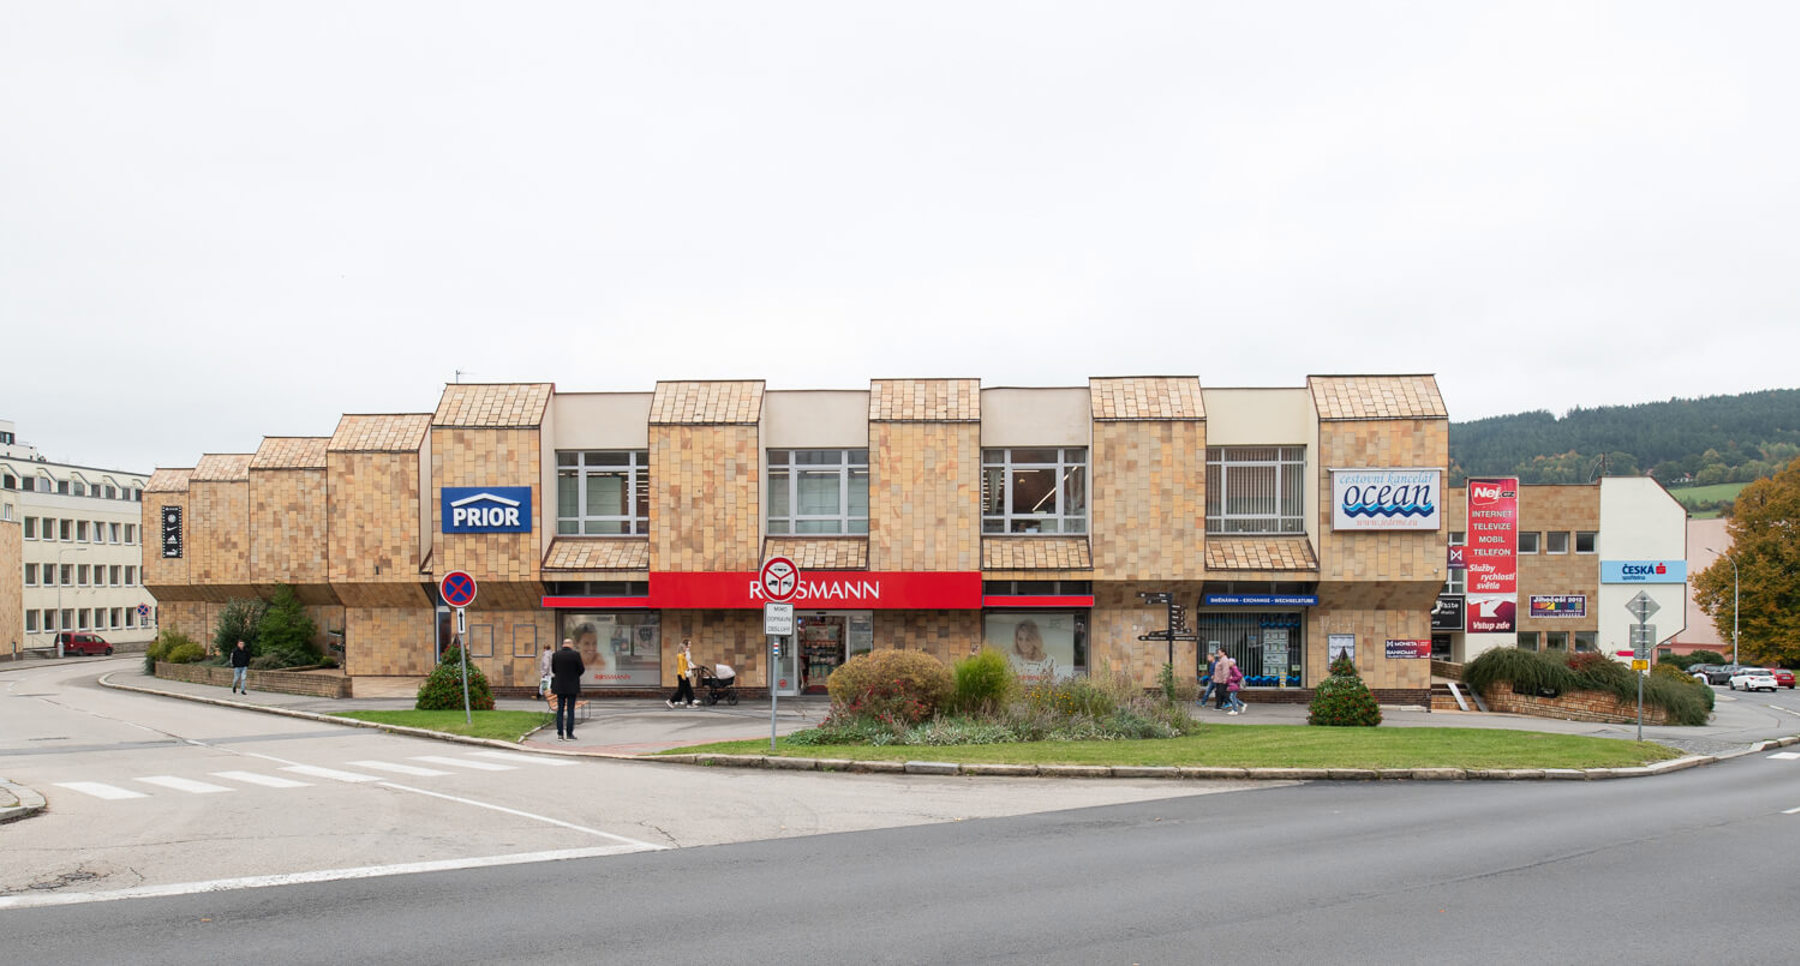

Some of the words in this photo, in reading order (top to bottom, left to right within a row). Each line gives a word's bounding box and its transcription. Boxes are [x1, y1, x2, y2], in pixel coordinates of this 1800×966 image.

[1340, 474, 1384, 484] cestovní
[1344, 484, 1432, 506] ocean
[453, 507, 521, 527] PRIOR
[1472, 510, 1513, 518] INTERNET
[1474, 548, 1511, 556] TELEFON
[1470, 564, 1496, 573] Služby
[1622, 563, 1655, 575] ČESKÁ
[749, 580, 880, 600] RSMANN
[1476, 582, 1500, 590] světla
[1472, 622, 1494, 631] Vstup
[1496, 621, 1511, 630] zde
